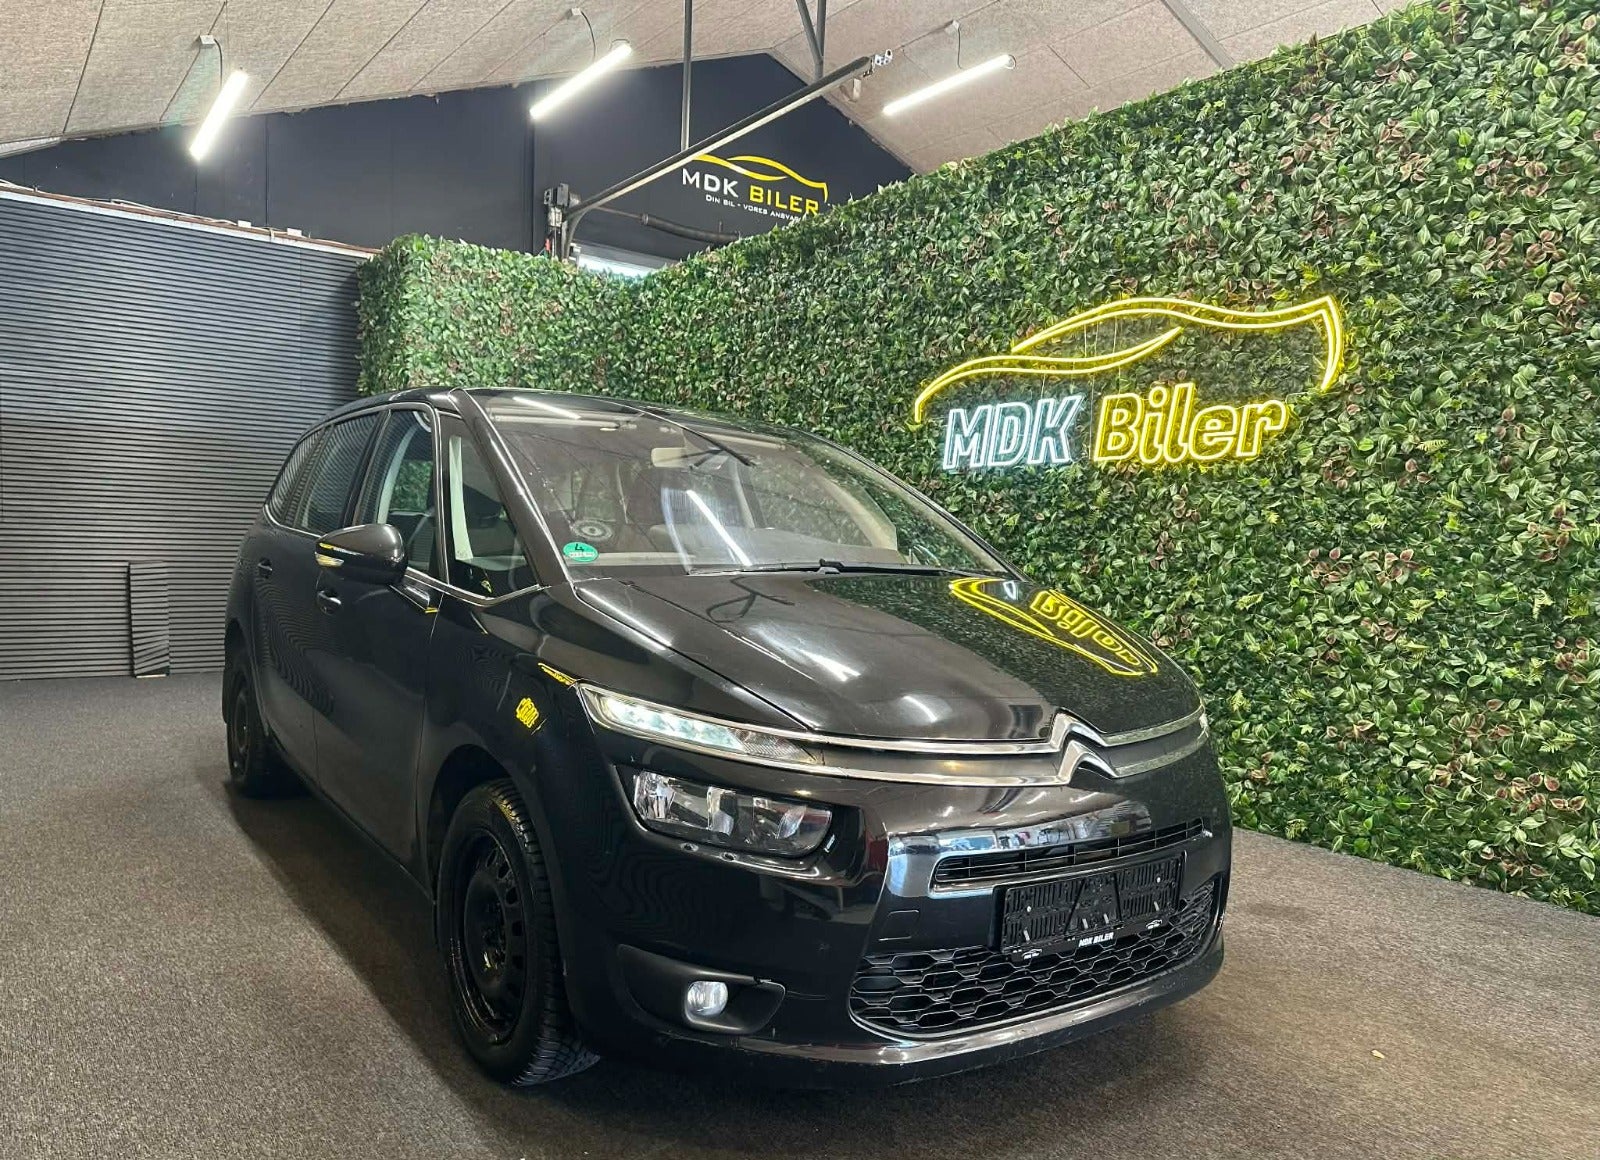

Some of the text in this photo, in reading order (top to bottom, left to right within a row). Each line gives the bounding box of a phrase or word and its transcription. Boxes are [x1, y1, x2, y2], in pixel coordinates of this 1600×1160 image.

[682, 168, 820, 216] MDK BILER
[705, 194, 720, 204] DIN
[723, 199, 735, 208] BIL
[942, 382, 1288, 470] MDK Biler
